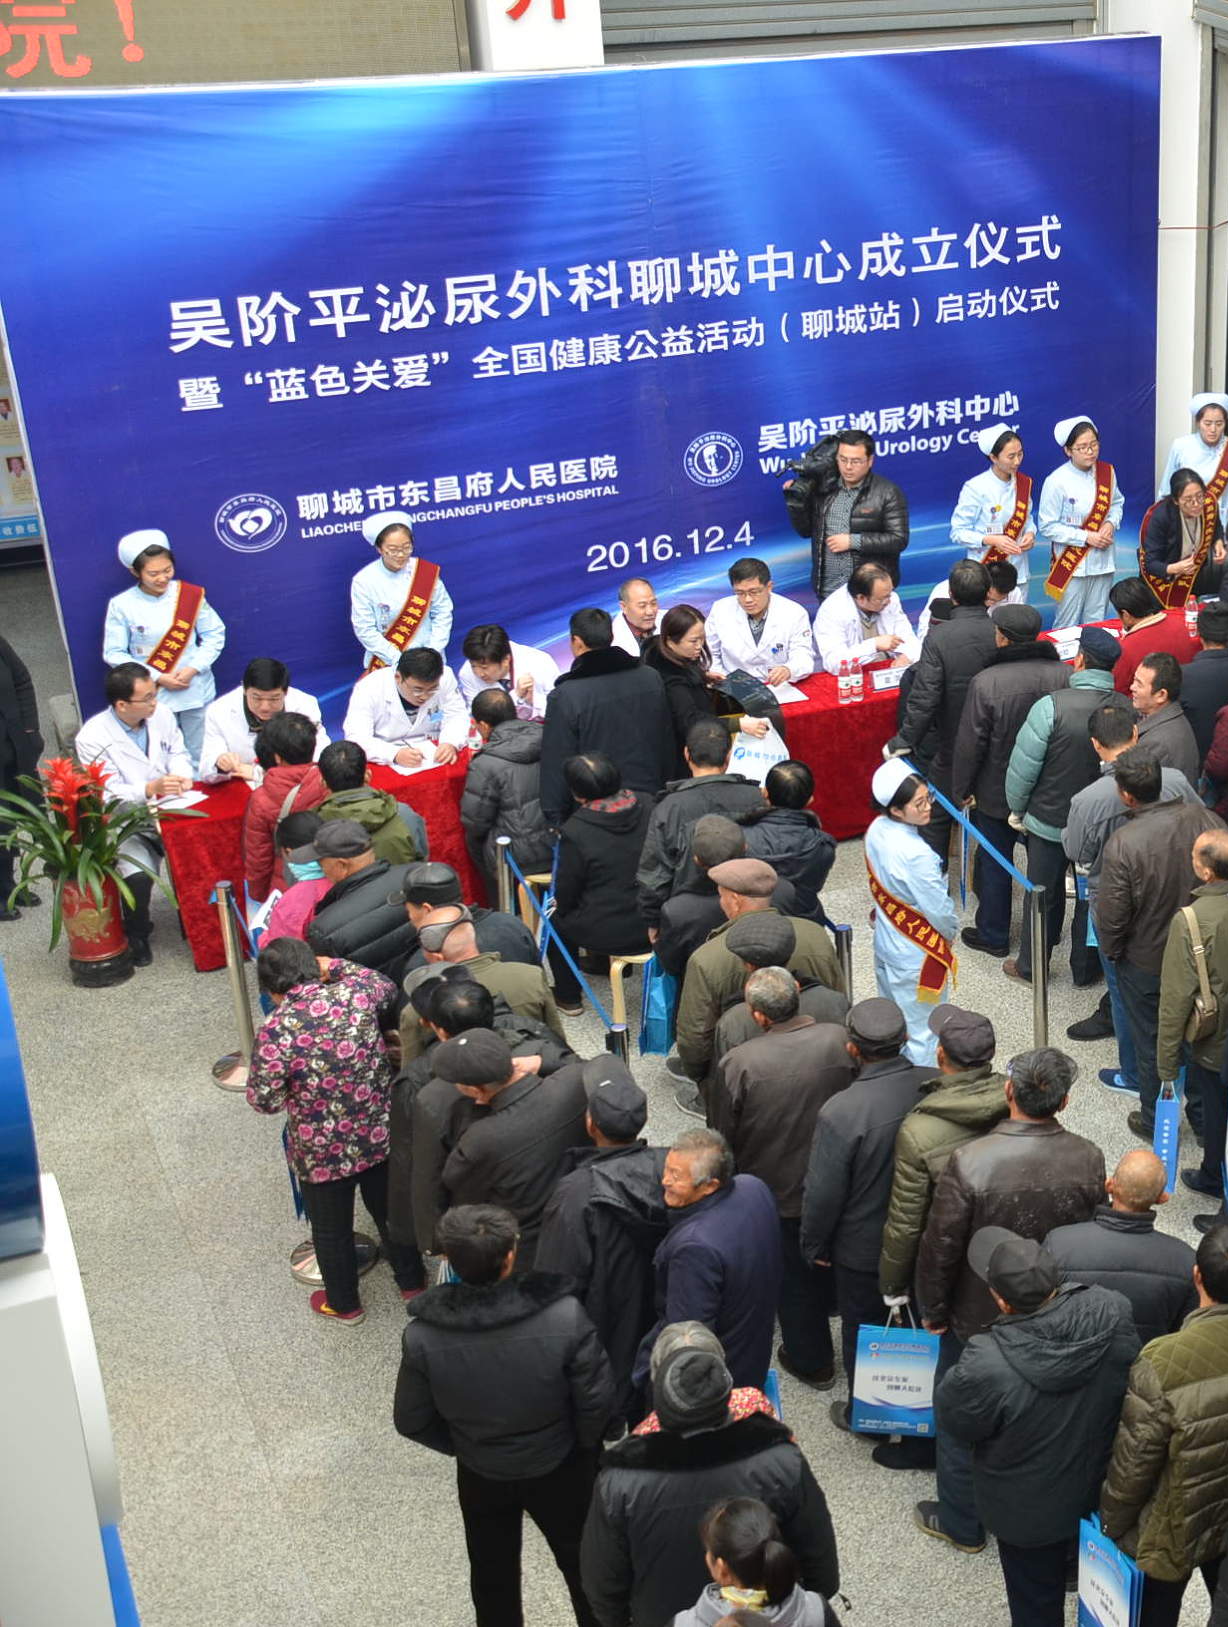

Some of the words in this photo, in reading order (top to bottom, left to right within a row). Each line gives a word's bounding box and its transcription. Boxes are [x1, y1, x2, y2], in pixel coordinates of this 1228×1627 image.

[169, 214, 1062, 353] 吴阶平泌尿外科聊城中心成立仪式
[875, 433, 952, 457] Urology
[296, 454, 619, 521] 聊城市东昌府人民医院
[494, 493, 556, 511] PEOPLE'S
[556, 484, 620, 503] HOSPITAL
[586, 520, 755, 573] 2016.12.4
